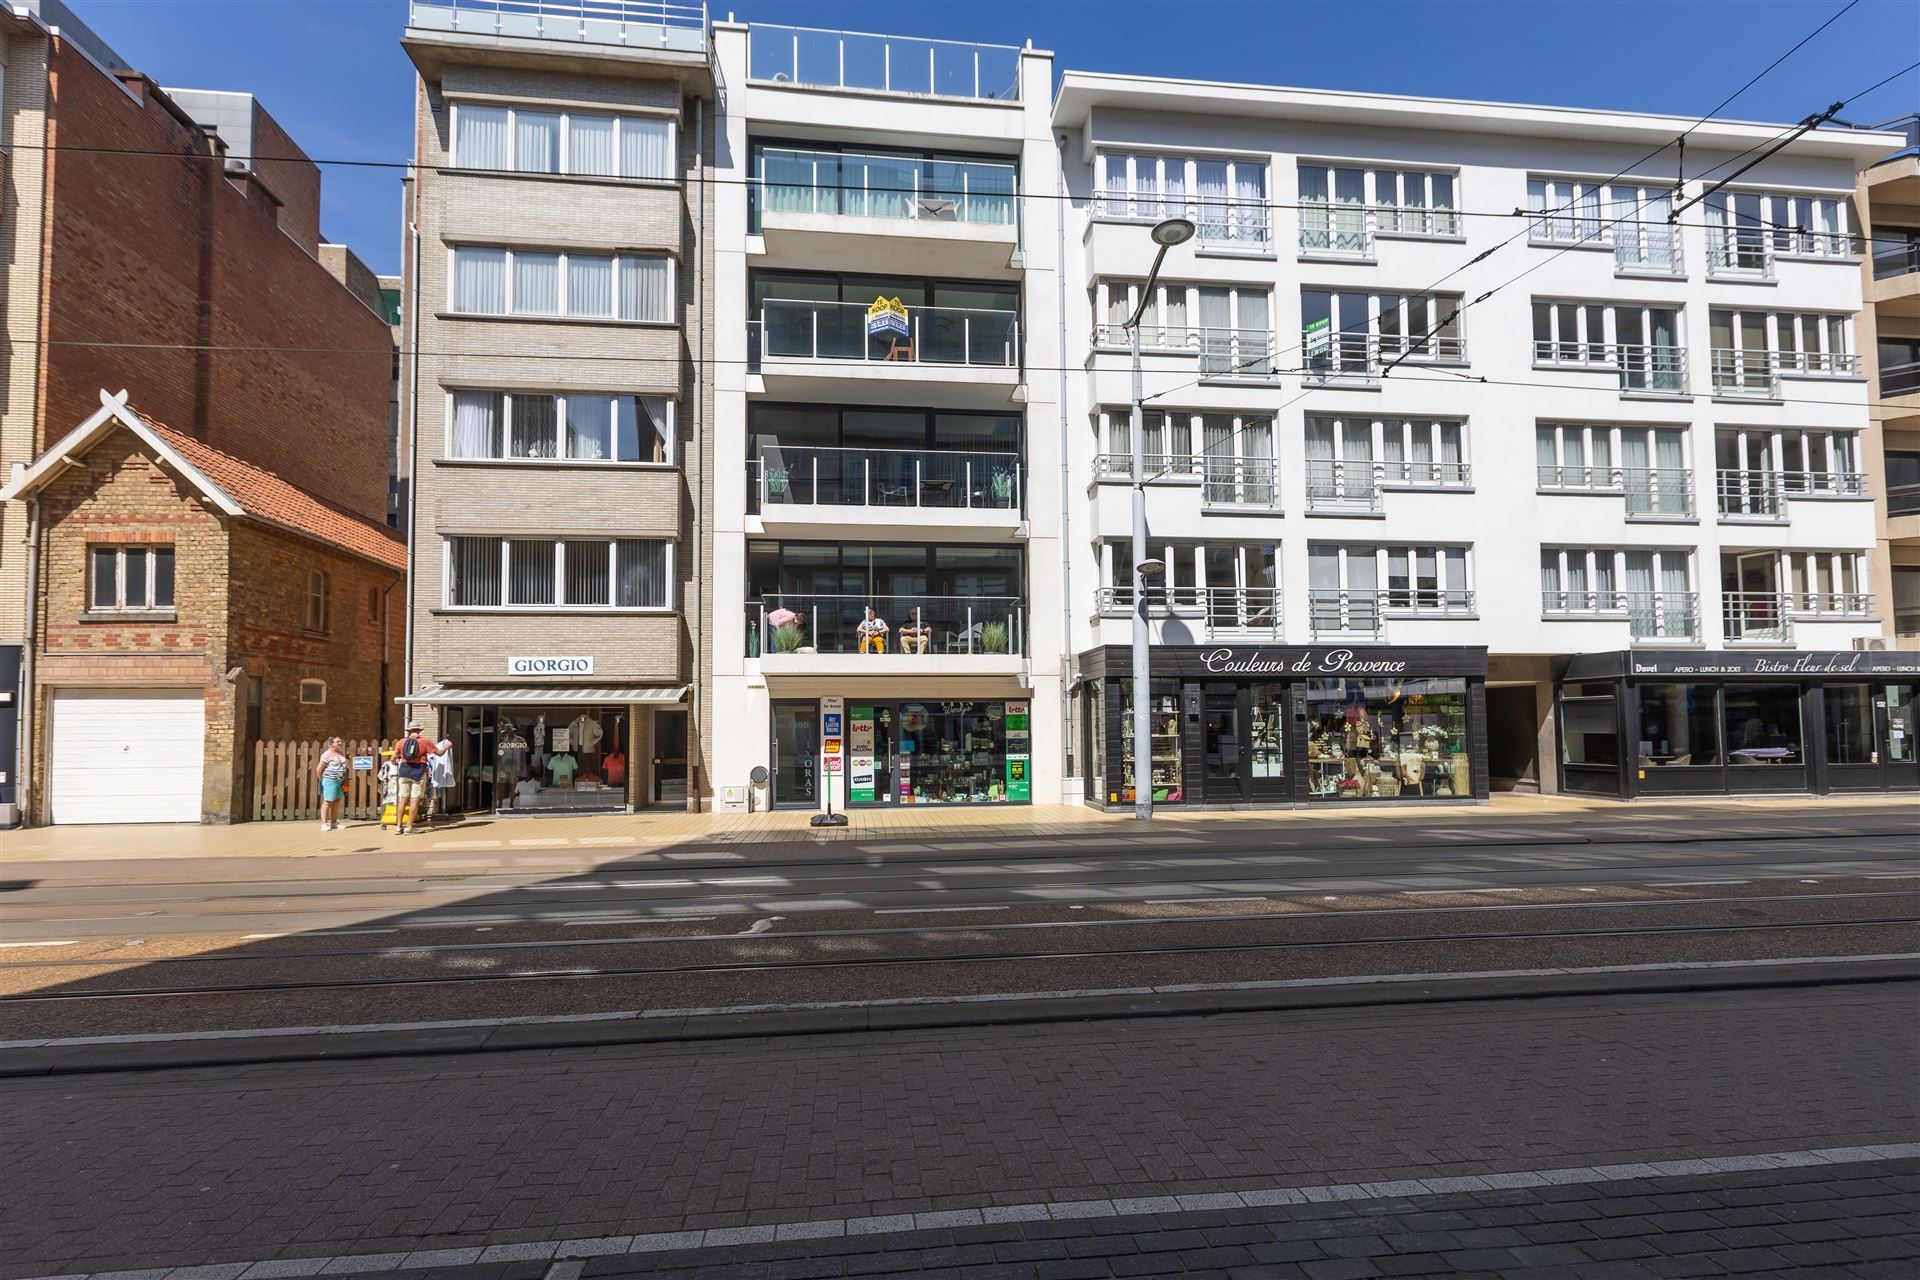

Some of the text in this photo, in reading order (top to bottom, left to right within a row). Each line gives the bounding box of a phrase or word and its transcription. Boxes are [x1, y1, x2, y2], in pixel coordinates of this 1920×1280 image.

[514, 659, 589, 672] GIORGIO
[1200, 648, 1406, 673] Couleurs de Provence
[1635, 663, 1658, 673] Duvel
[1754, 652, 1861, 673] Bistro Fleur de sel
